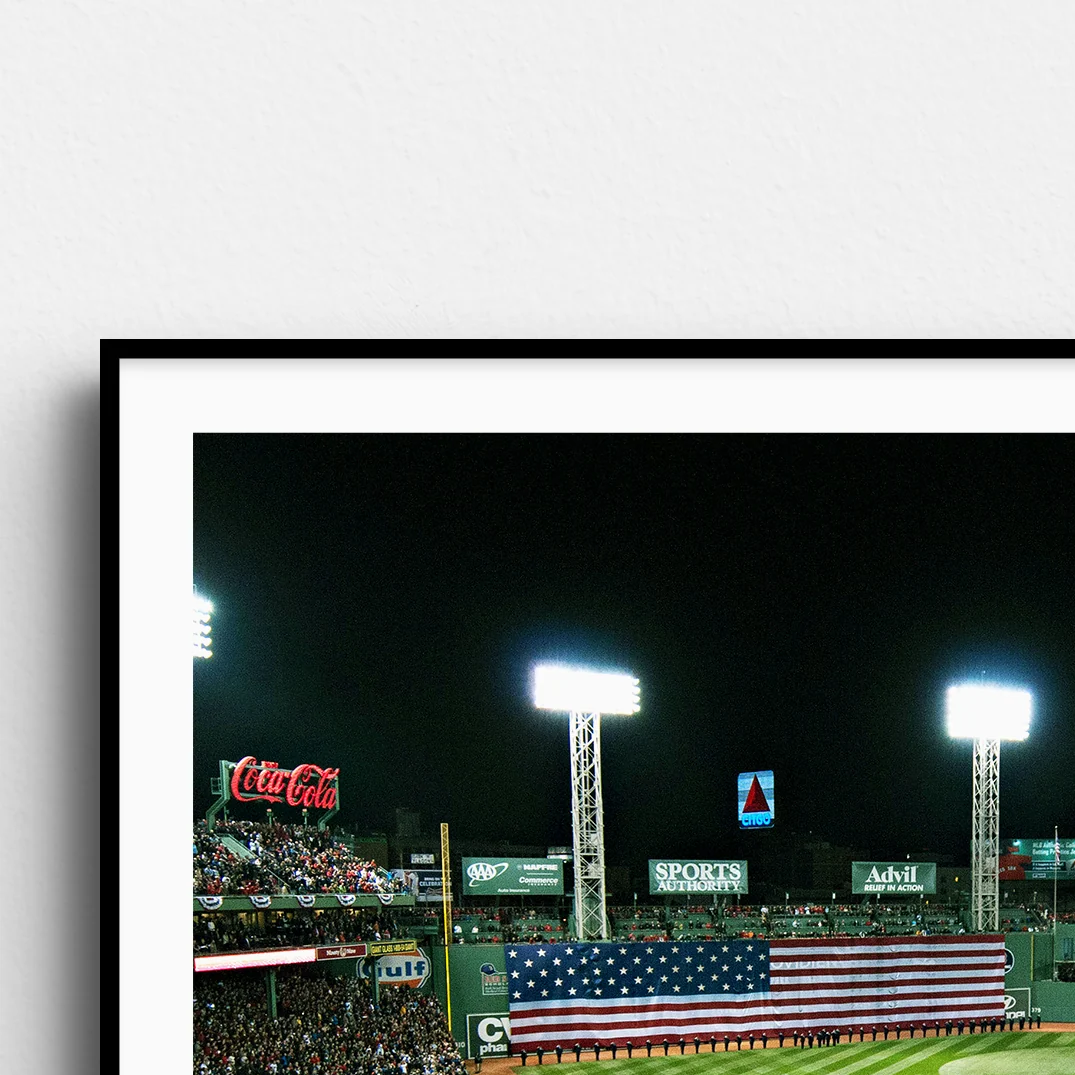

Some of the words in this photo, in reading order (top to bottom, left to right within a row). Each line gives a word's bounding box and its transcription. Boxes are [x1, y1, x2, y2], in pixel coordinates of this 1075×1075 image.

[231, 755, 340, 810] Coca-Cola
[741, 812, 771, 826] CITGO
[655, 862, 741, 881] SPORTS
[865, 865, 917, 883] Advil
[518, 876, 559, 884] Commerce
[657, 880, 741, 892] AUTHORITY
[864, 884, 886, 892] RELIEF
[887, 884, 896, 892] IN
[897, 884, 924, 892] ACTION
